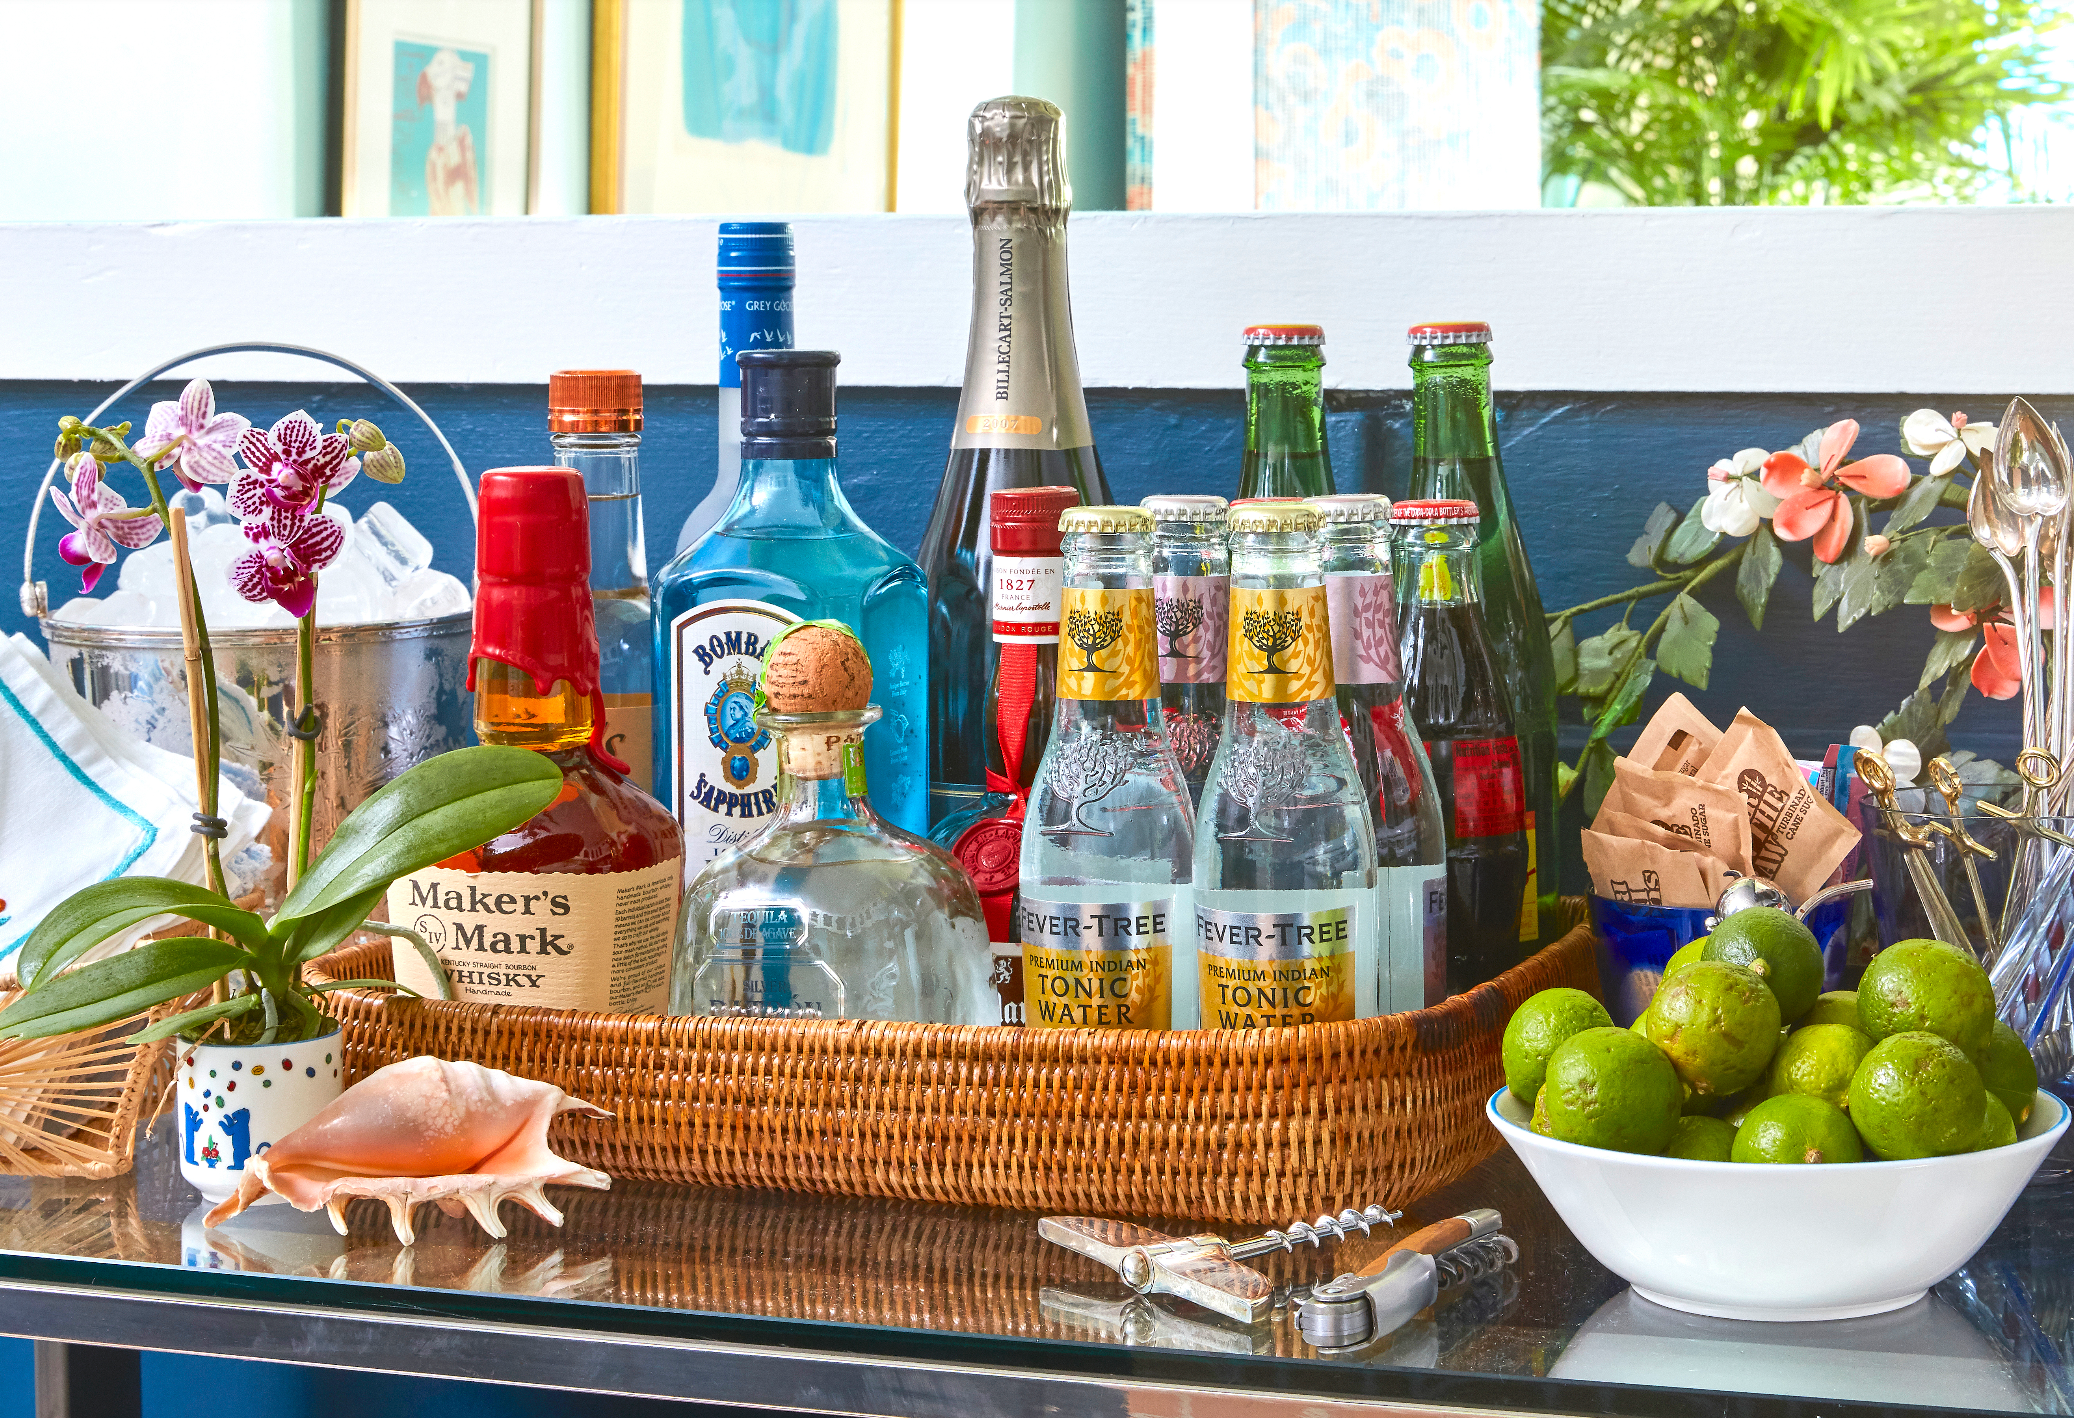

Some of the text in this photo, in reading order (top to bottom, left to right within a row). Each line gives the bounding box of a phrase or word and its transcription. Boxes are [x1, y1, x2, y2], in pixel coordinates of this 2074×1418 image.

[745, 300, 771, 311] GREY
[995, 237, 1013, 401] BILLECART-SALMON
[982, 419, 1019, 430] 2007
[1009, 567, 1041, 575] FONDÉE
[999, 578, 1035, 591] 1827
[1001, 593, 1031, 601] FRANCE
[691, 630, 772, 676] BOMBA
[1698, 803, 1710, 837] SUGAR
[1776, 785, 1808, 835] TURBINAD
[1785, 814, 1804, 841] CANE
[408, 879, 571, 916] Maker's
[730, 910, 788, 924] TEQUILA
[1020, 912, 1166, 938] FEVER-TREE
[762, 927, 796, 940] AGAVE
[1197, 914, 1348, 947] FEVER-TREE
[441, 958, 537, 971] KENTUCKY STRAIGHT BOURBON
[1029, 954, 1147, 973] PREMIUM INDIAN
[1208, 963, 1331, 982] PREMIUM INDIAN
[465, 986, 512, 997] Handmade
[1037, 973, 1129, 1000] TONIC
[1217, 983, 1313, 1009] TONIC
[1037, 1000, 1135, 1026] WATER
